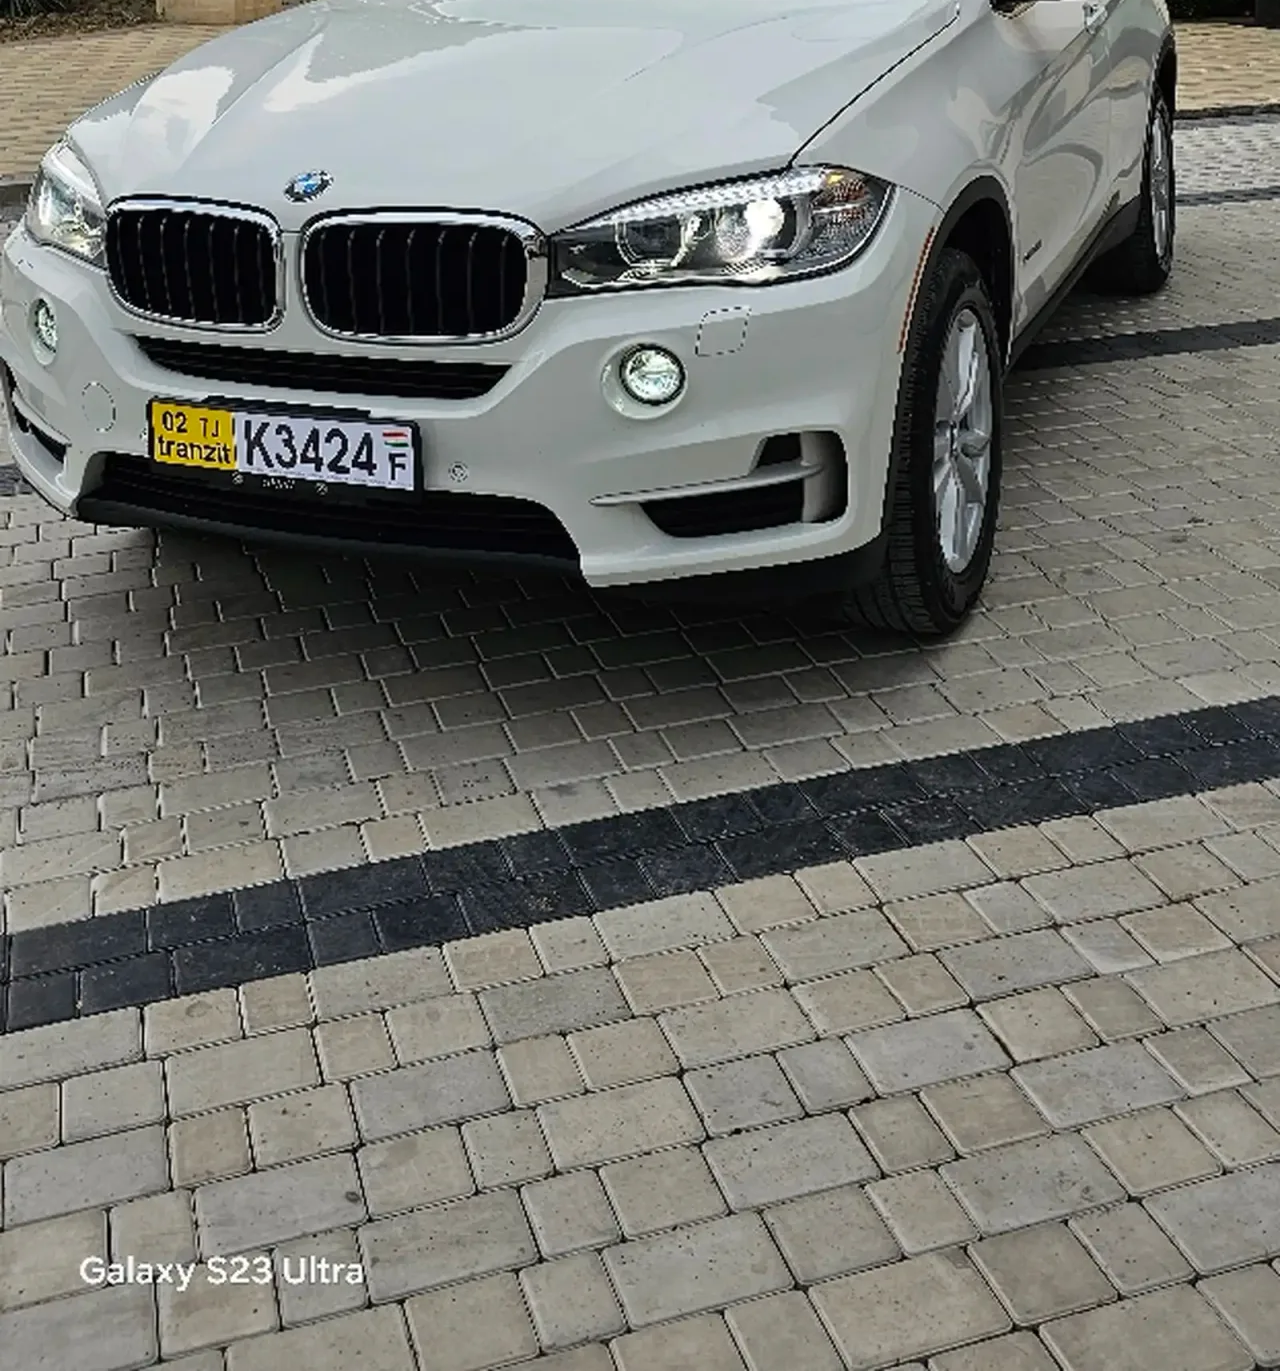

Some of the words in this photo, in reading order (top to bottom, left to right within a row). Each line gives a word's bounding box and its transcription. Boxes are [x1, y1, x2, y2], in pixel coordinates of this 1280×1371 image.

[161, 411, 188, 433] 02
[199, 417, 220, 438] TJ
[157, 434, 231, 464] tranzit
[243, 419, 377, 476] K3424
[388, 452, 407, 480] F
